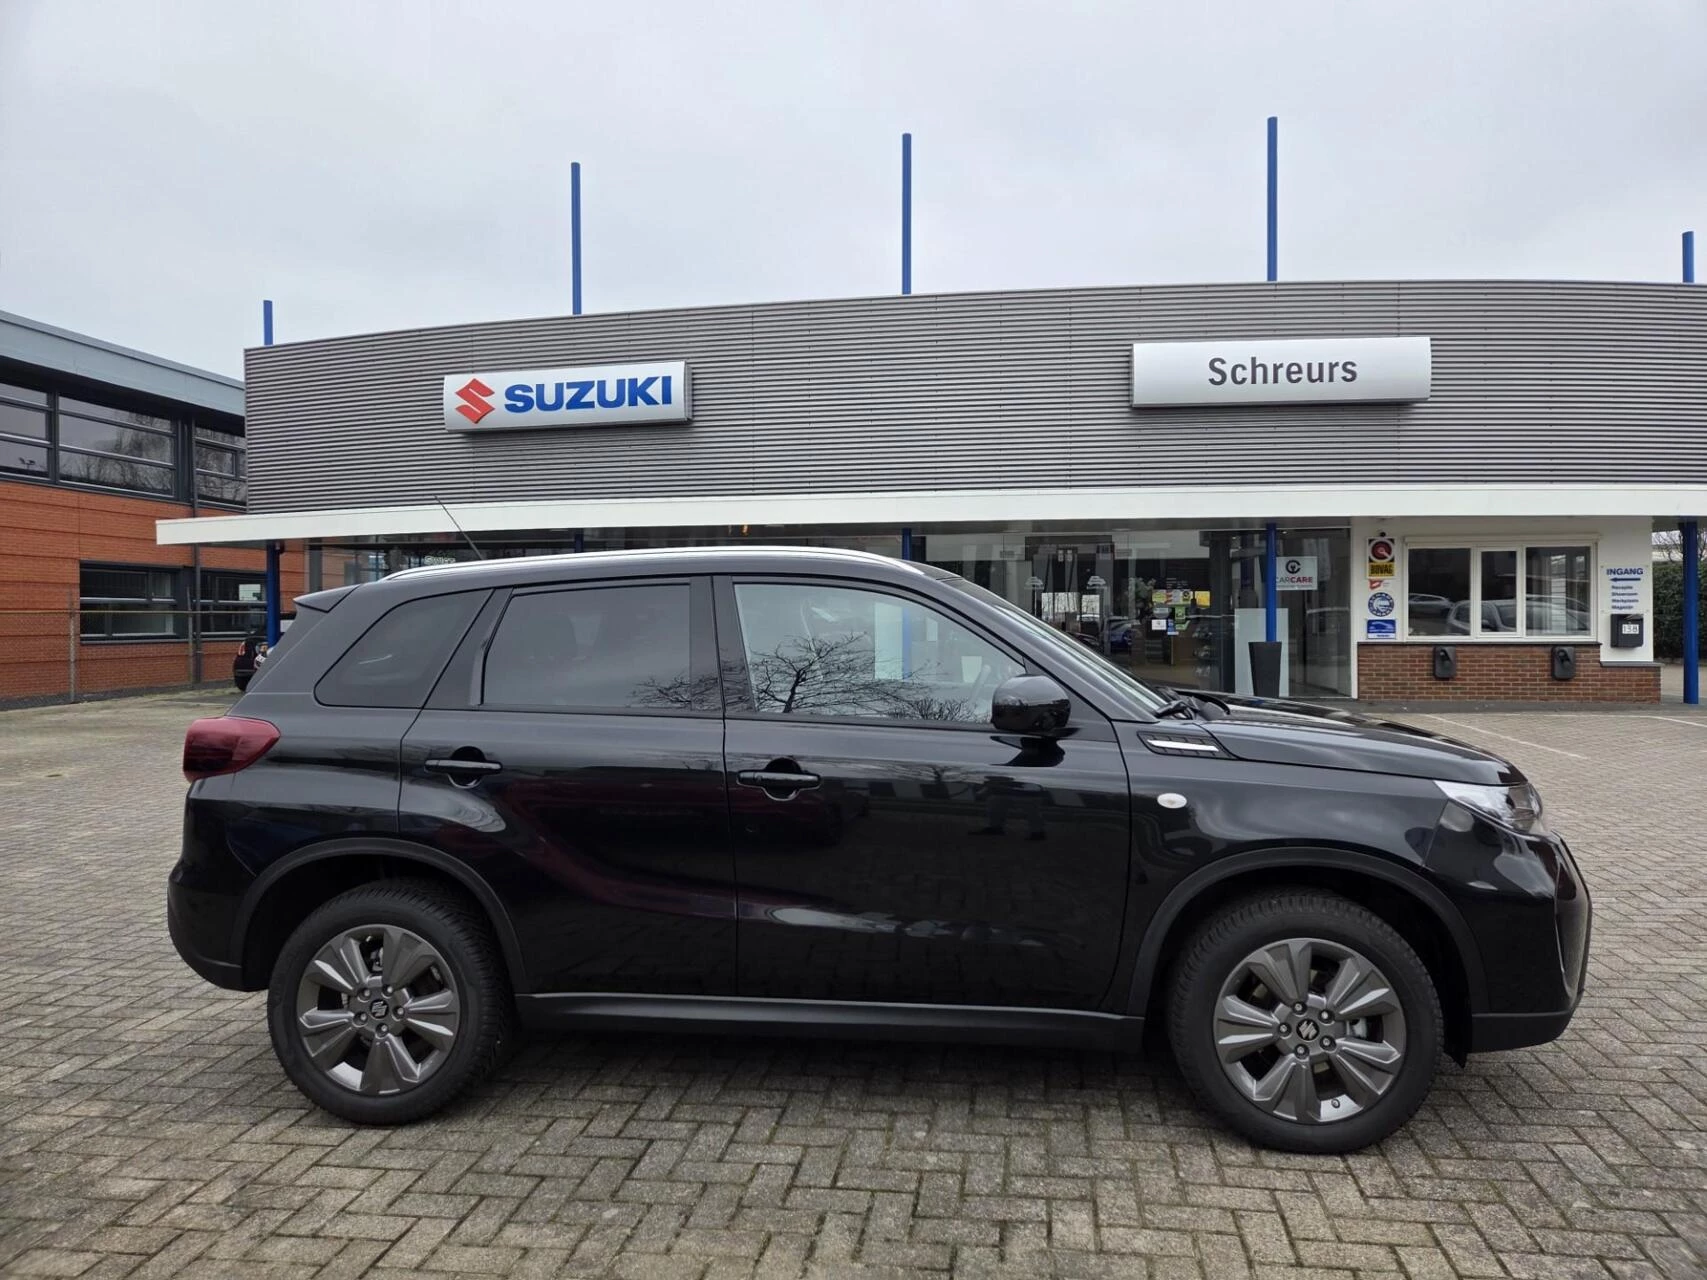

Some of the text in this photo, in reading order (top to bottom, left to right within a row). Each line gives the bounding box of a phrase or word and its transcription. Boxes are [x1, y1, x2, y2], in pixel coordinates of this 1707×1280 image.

[1208, 356, 1358, 386] Schreurs
[504, 375, 672, 413] SUZUKI
[1606, 567, 1644, 576] INGANG
